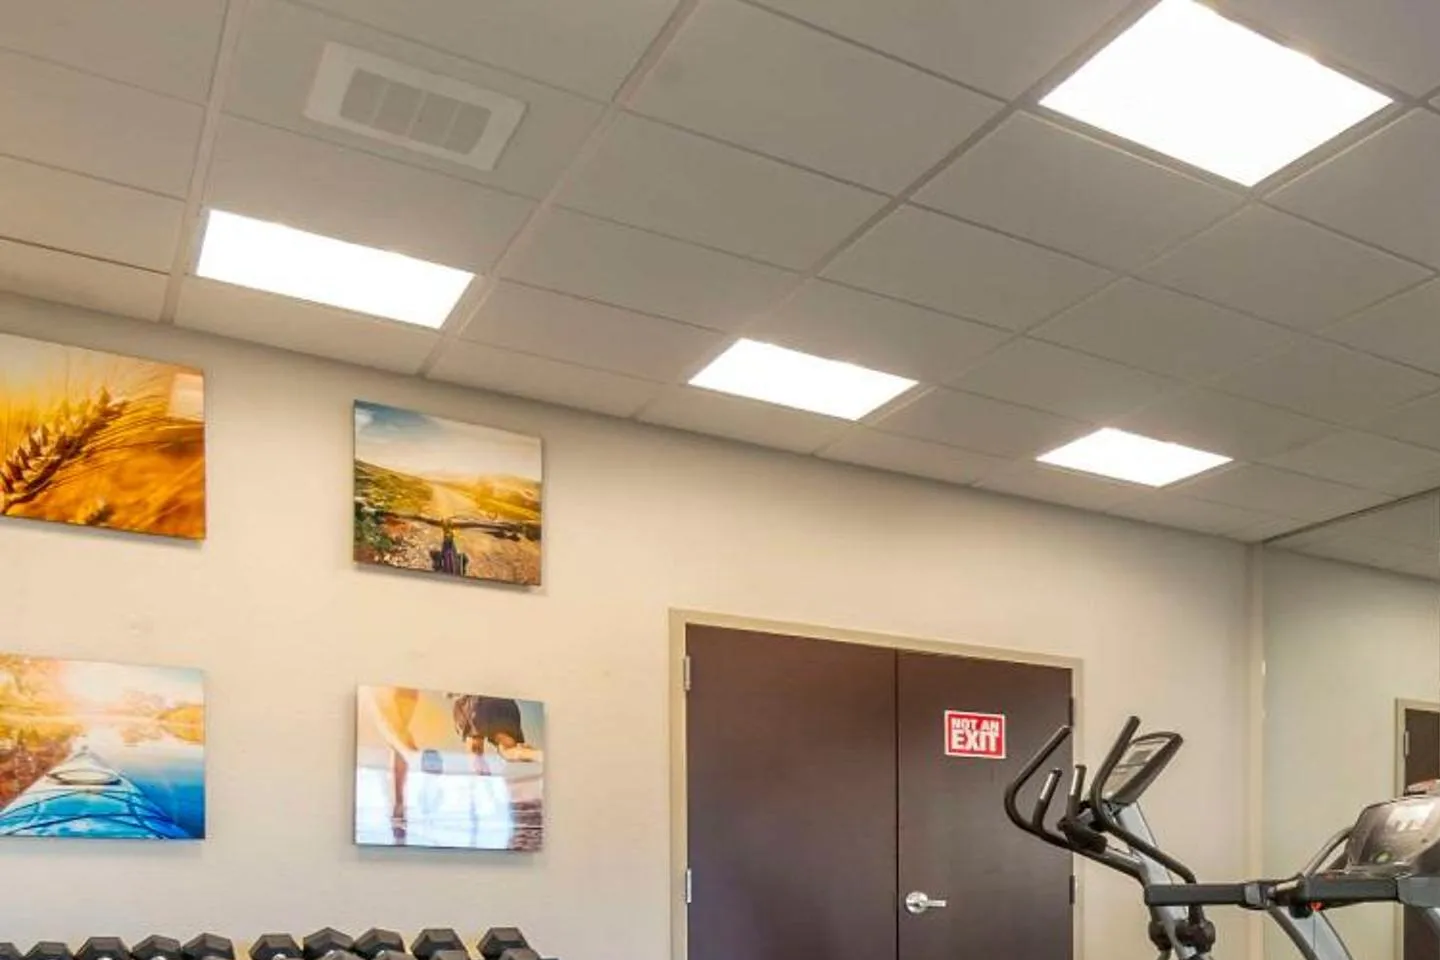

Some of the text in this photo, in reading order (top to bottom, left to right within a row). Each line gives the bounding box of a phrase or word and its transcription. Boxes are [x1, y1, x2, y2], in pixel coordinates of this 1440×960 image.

[951, 717, 1000, 734] NOT AN
[951, 730, 999, 752] EXIT
